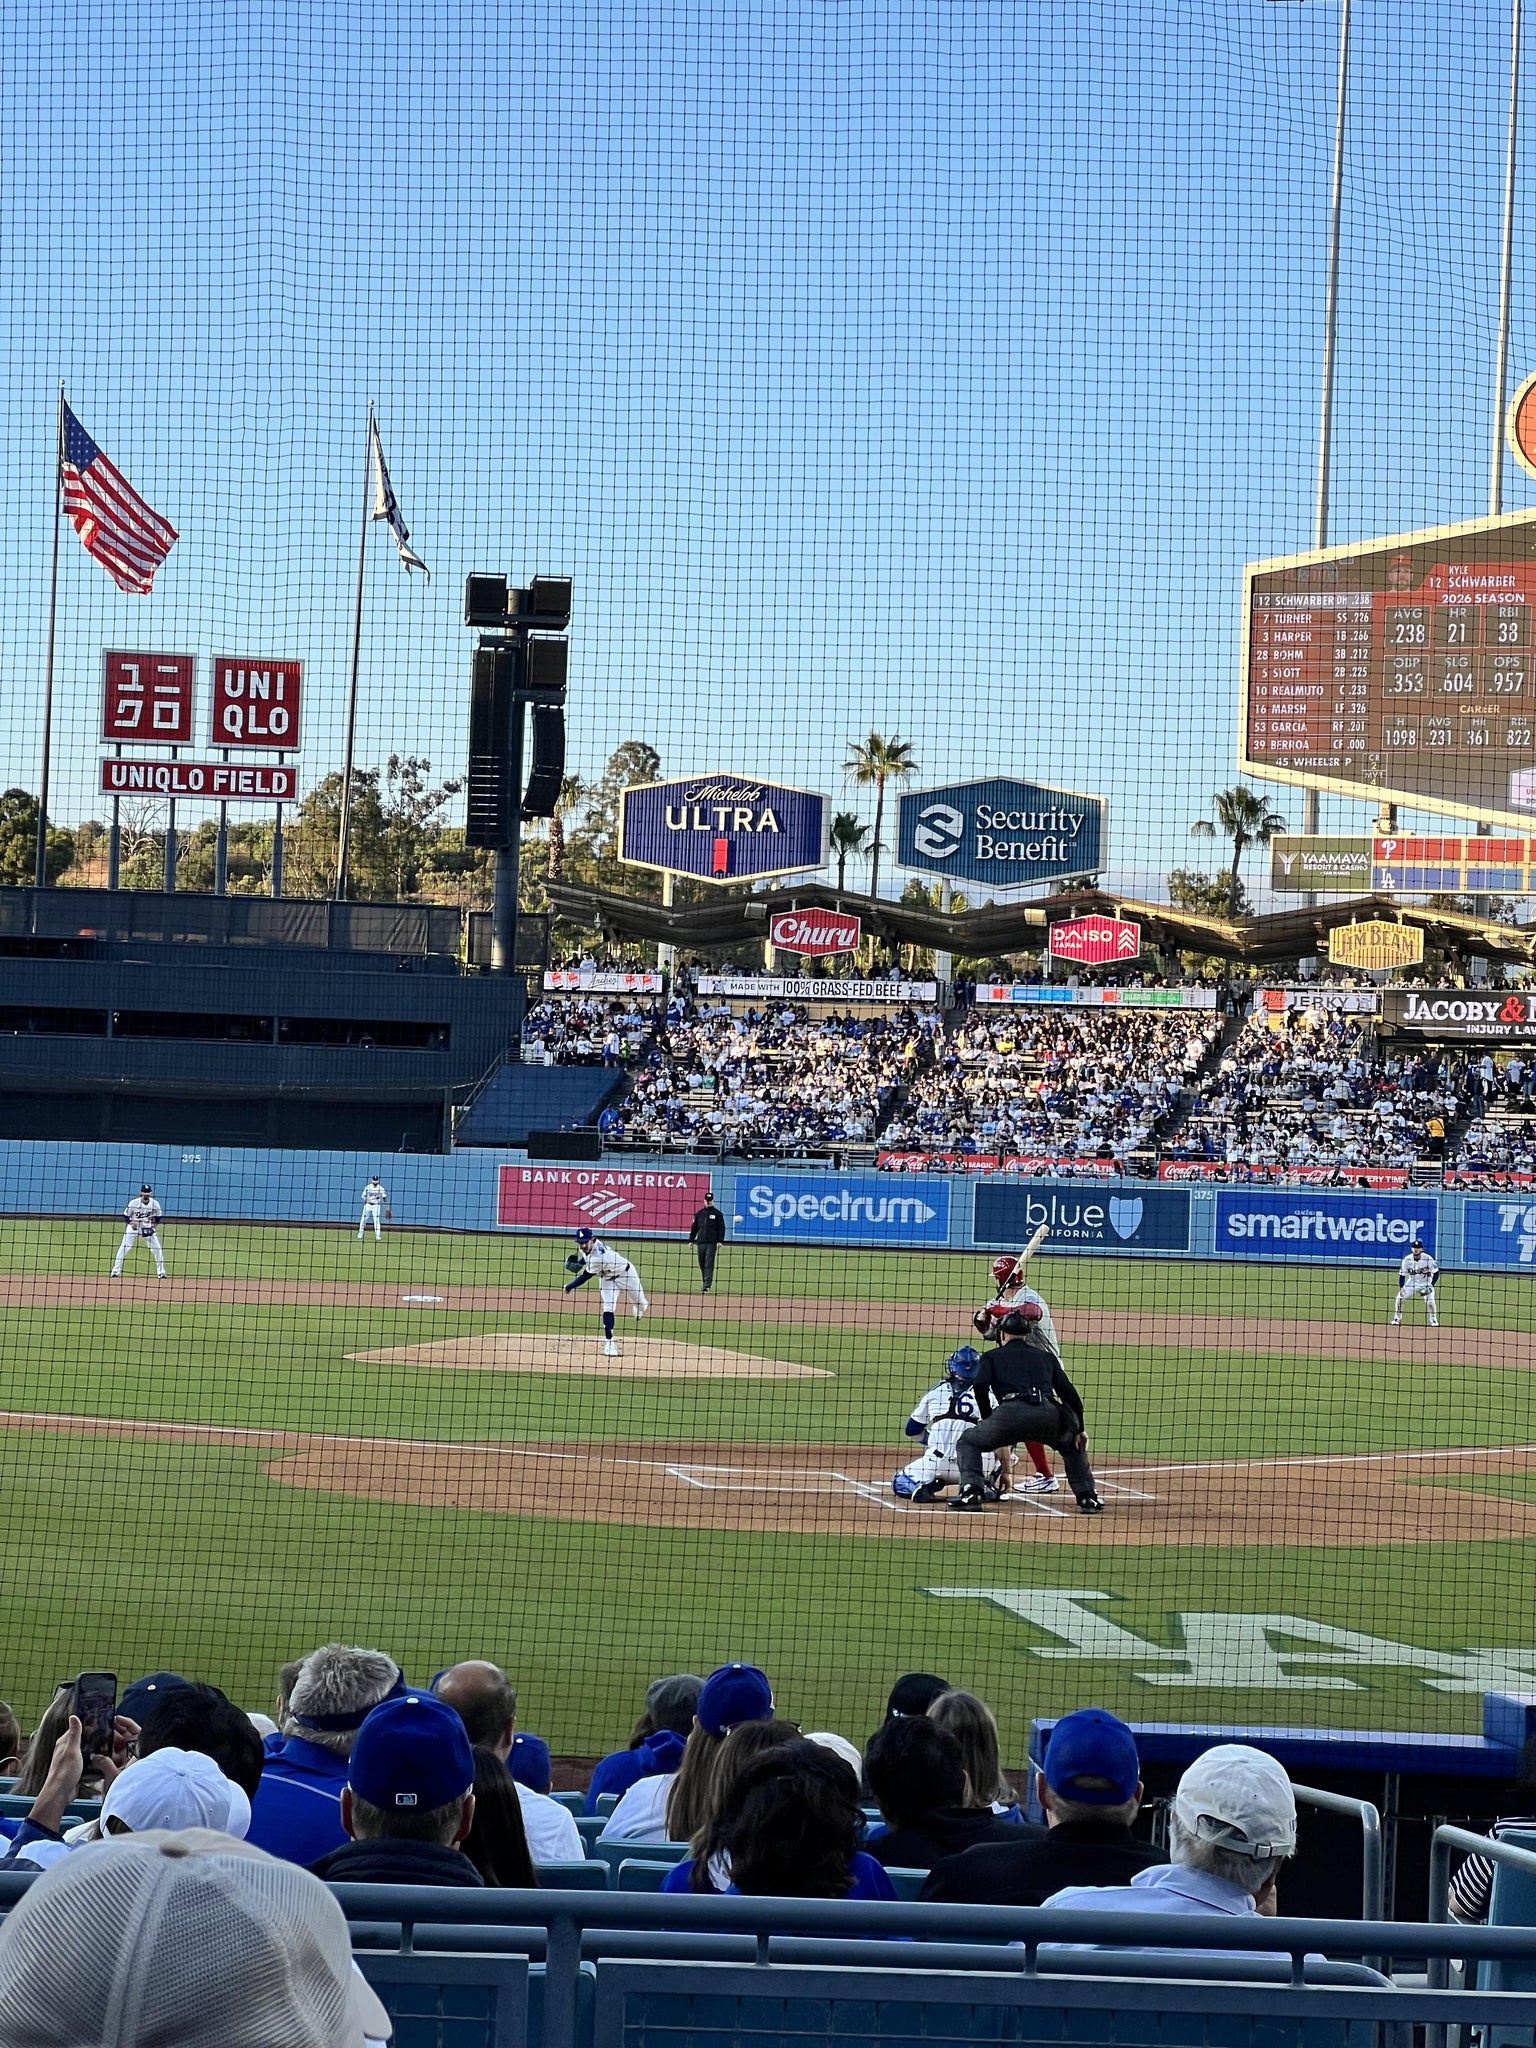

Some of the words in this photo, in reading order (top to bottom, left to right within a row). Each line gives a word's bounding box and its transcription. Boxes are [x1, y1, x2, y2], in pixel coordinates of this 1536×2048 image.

[1449, 566, 1469, 575] KYLE
[1430, 578, 1441, 588] 12
[1448, 576, 1516, 588] SCHWARBER
[1258, 597, 1270, 606] 12
[1275, 596, 1334, 606] SCHWARBER
[1441, 594, 1472, 604] 2026
[1475, 593, 1525, 603] SEASON
[1263, 614, 1269, 624] 7
[1274, 614, 1312, 624] TURNER
[1337, 613, 1347, 623] SS
[1351, 612, 1369, 623] .226
[1394, 608, 1423, 619] AVG
[1449, 607, 1467, 618] HR
[1499, 607, 1519, 617] RBI
[1263, 632, 1269, 642] 3
[1274, 631, 1312, 642] HARPER
[1350, 631, 1369, 641] .266
[1390, 624, 1425, 643] .238
[1448, 623, 1466, 643] 21
[1499, 623, 1518, 642] 38
[1256, 650, 1268, 660] 28
[1273, 650, 1304, 660] BOHM
[1335, 649, 1346, 659] 3B
[1350, 649, 1368, 659] .212
[1393, 657, 1420, 668] OBP
[1444, 657, 1469, 668] SLG
[1494, 657, 1520, 667] OPS
[1262, 668, 1268, 678] 5
[1273, 668, 1301, 677] STOTT
[1334, 667, 1345, 677] 2B
[1349, 667, 1367, 677] .225
[224, 669, 284, 701] UNI
[1388, 673, 1424, 693] .353
[1438, 673, 1474, 692] .604
[1488, 673, 1525, 692] .957
[1256, 686, 1267, 695] 10
[1272, 686, 1324, 695] REALMUTO
[1348, 685, 1367, 695] .233
[1255, 704, 1267, 714] 16
[1271, 704, 1307, 714] MARSH
[1335, 703, 1345, 713] LF
[1348, 703, 1366, 713] .326
[1460, 705, 1500, 714] CAREER
[223, 704, 289, 738] QLO
[1254, 722, 1266, 732] 53
[1332, 722, 1344, 731] RF
[1397, 718, 1404, 726] H
[1428, 718, 1451, 726] AVG
[1473, 718, 1486, 726] HR
[1386, 730, 1416, 745] 1098
[1425, 730, 1452, 745] .231
[1467, 730, 1489, 745] 361
[1506, 730, 1531, 745] 822
[1253, 740, 1266, 750] 39
[1270, 740, 1309, 750] BERROA
[1333, 740, 1343, 749] CF
[1347, 740, 1365, 749] .000
[1276, 758, 1289, 766] 45
[1293, 758, 1340, 767] WHEELER
[1345, 758, 1352, 766] P
[111, 764, 205, 793] UNIQLO
[213, 769, 288, 794] FIELD
[684, 783, 764, 802] Michelob
[665, 805, 780, 833] ULTRA
[976, 804, 1085, 838] Security
[975, 834, 1069, 862] Benefit
[1382, 840, 1397, 860] P
[773, 918, 856, 946] Churu
[1054, 929, 1113, 942] DAISO
[1336, 932, 1366, 958] JIM
[1370, 925, 1414, 958] BEAM
[730, 983, 755, 991] MADE
[783, 981, 810, 995] 100%
[812, 981, 873, 996] GRASS-FED
[875, 984, 903, 997] BEEF
[1403, 994, 1502, 1022] JACOBY
[1500, 996, 1525, 1022] &
[1467, 1025, 1511, 1035] INJURY
[522, 1170, 571, 1184] BANK
[577, 1172, 600, 1185] OF
[604, 1173, 687, 1188] AMERICA
[1357, 1175, 1384, 1183] EERY
[1194, 1191, 1213, 1200] 375
[749, 1185, 926, 1227] Spectrum
[1026, 1194, 1105, 1228] blue
[1228, 1211, 1424, 1243] smartwater
